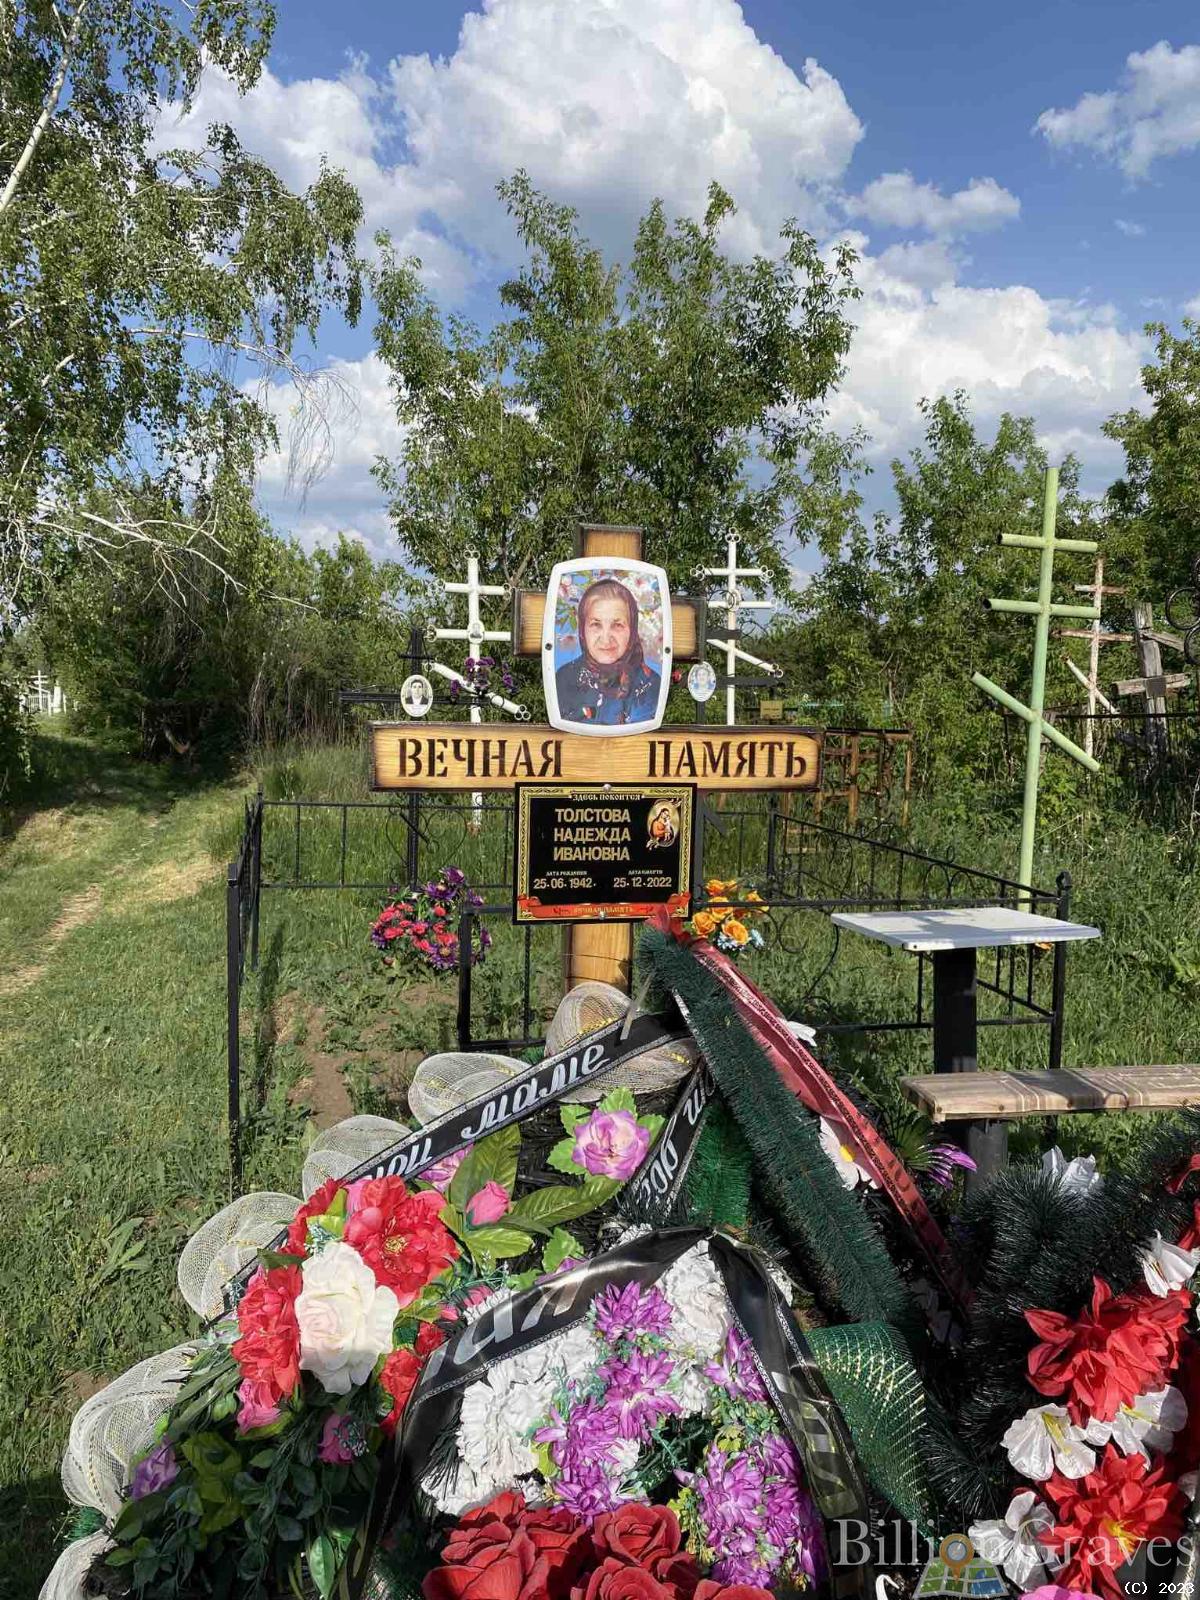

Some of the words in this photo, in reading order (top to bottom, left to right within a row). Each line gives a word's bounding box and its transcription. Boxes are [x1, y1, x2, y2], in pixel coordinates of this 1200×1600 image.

[397, 738, 563, 778] ВЕЧНАЯ
[647, 740, 808, 778] ПАМЯТЬ
[572, 794, 599, 802] ЗДЕСЬ
[554, 808, 631, 823] ТОЛСТОВА
[553, 827, 631, 844] НАДЕЖДА
[553, 847, 631, 861] ИВАНОВНА
[460, 1043, 610, 1140] маме
